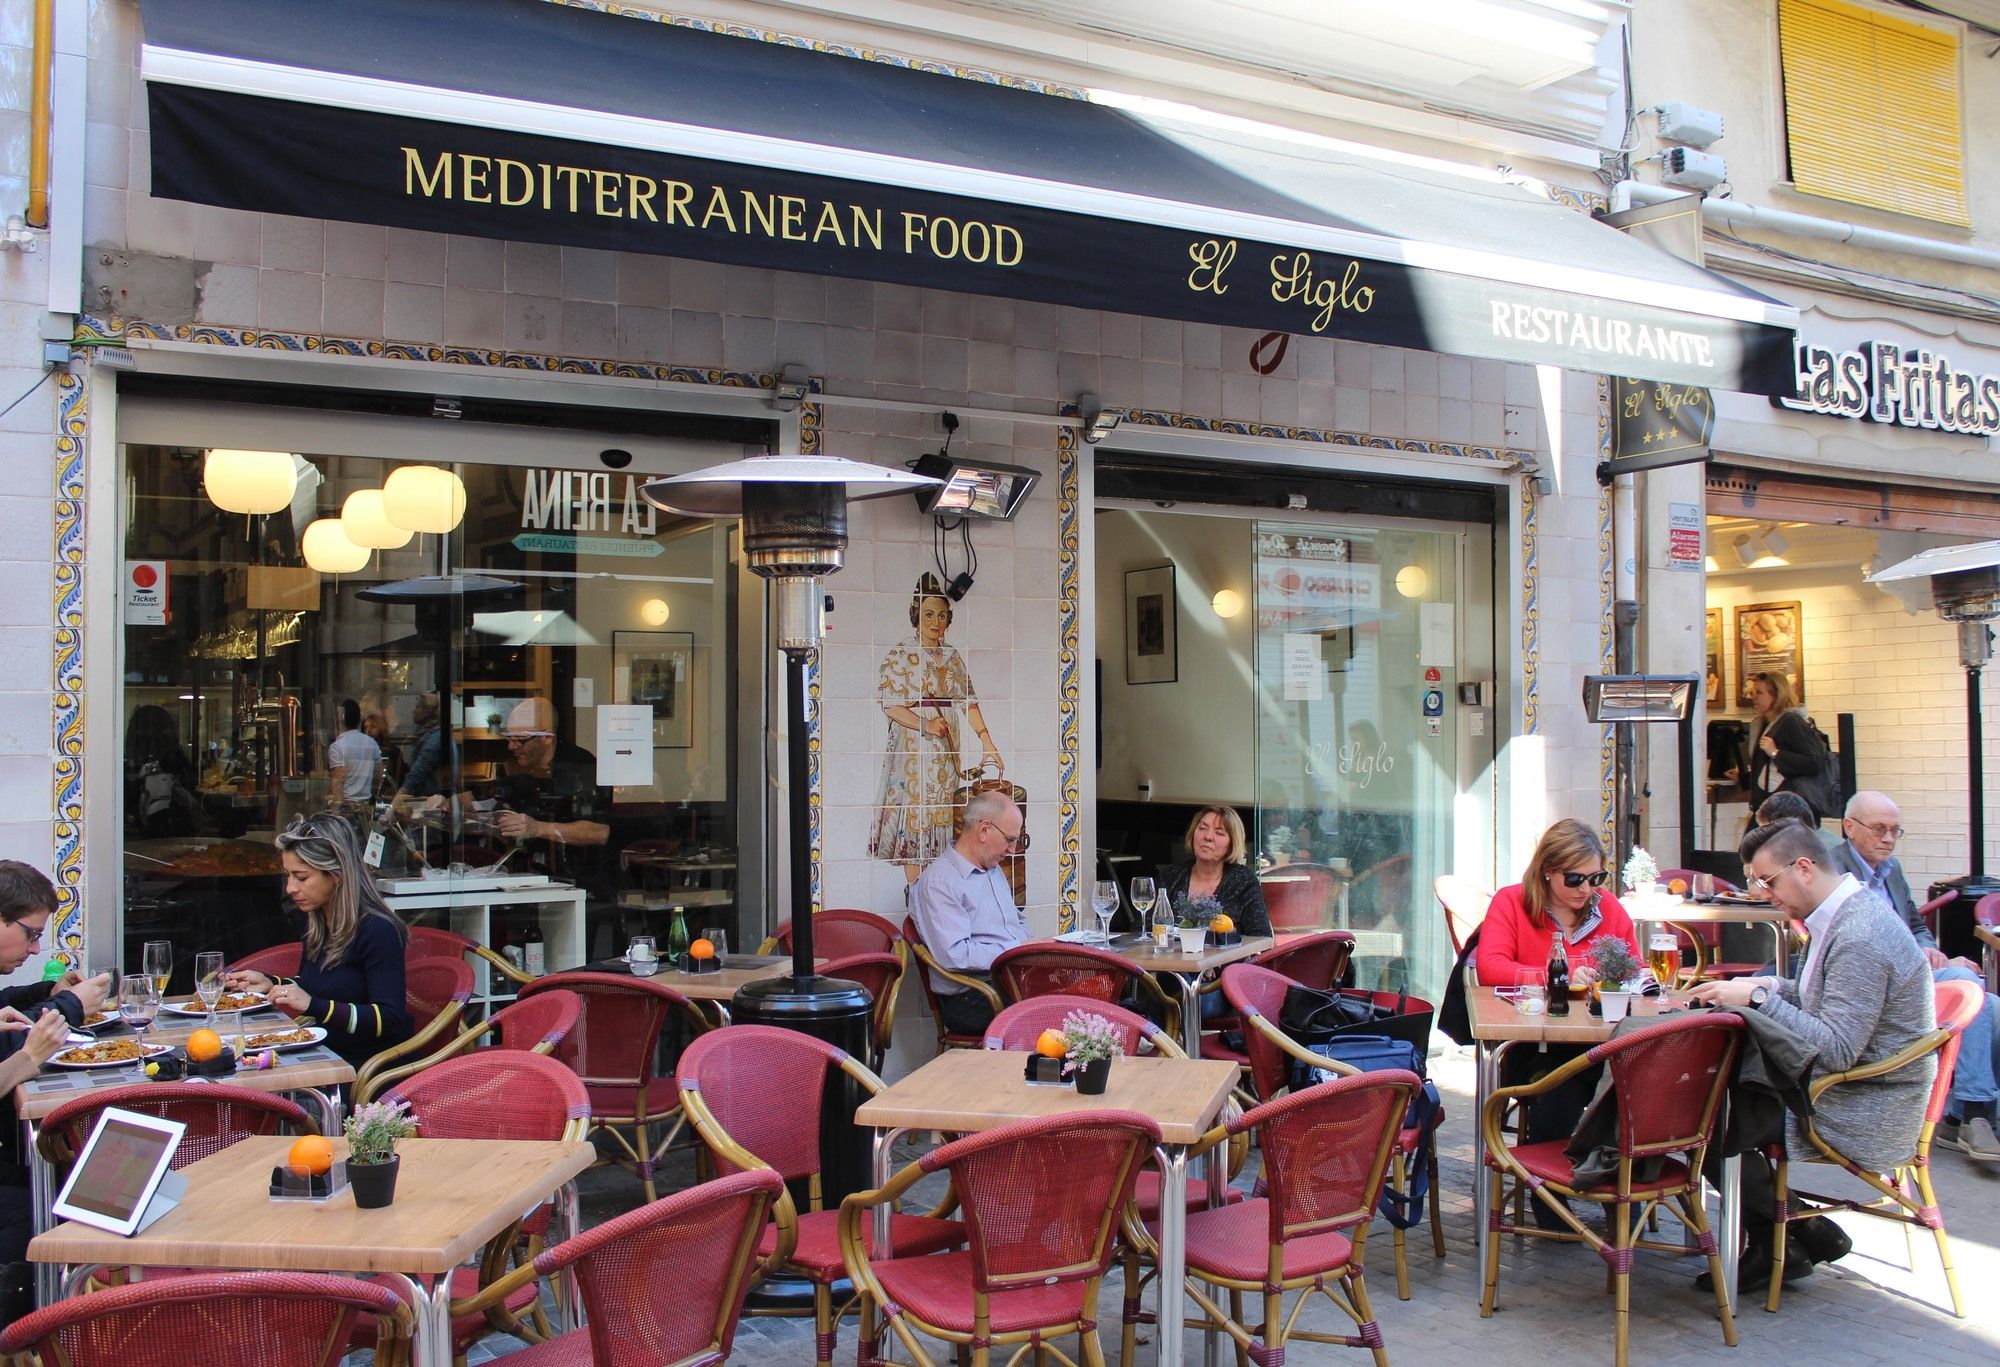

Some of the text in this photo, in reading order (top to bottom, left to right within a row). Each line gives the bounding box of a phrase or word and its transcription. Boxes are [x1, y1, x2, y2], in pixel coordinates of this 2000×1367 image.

[400, 147, 1024, 267] MEDITERRANEAN FOOD
[1187, 239, 1375, 333] El Siglo
[1489, 299, 1714, 368] RESTAURANTE
[1624, 389, 1646, 418] El
[1873, 341, 2000, 434] Fritas
